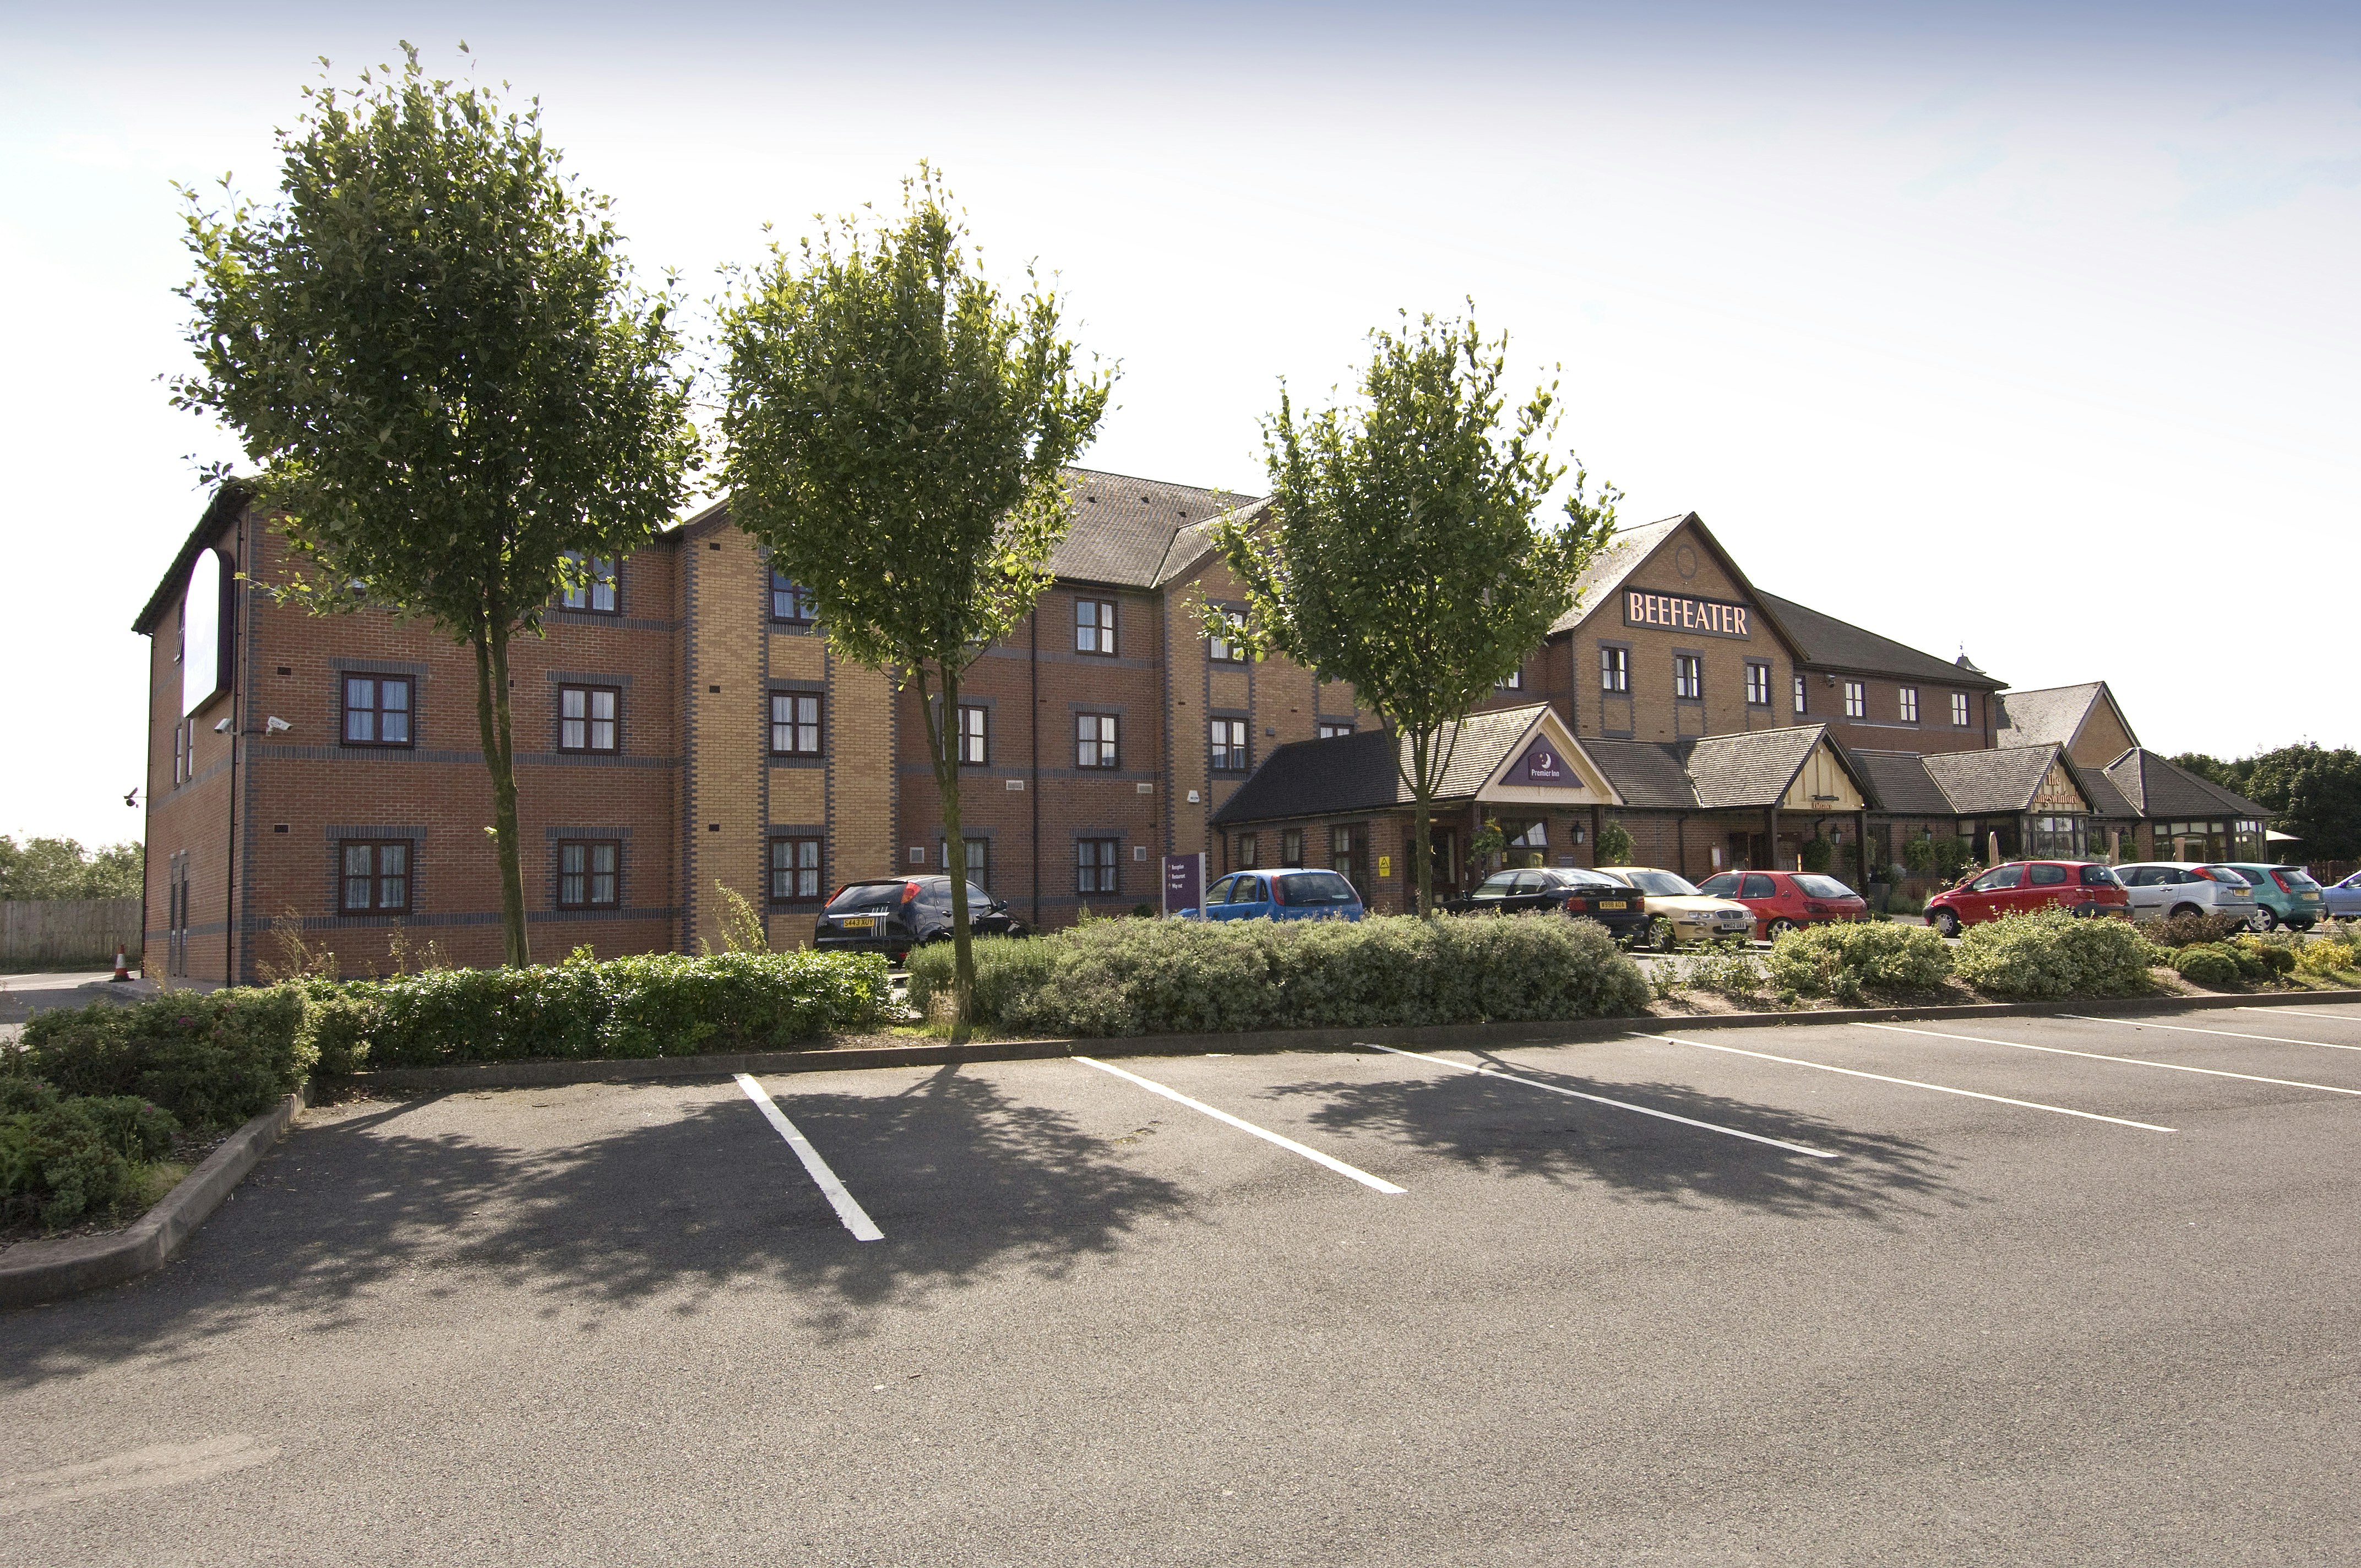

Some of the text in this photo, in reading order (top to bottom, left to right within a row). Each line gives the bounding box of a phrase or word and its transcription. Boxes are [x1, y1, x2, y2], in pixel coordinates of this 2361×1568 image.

[1629, 592, 1748, 635] BEEFEATER
[1531, 769, 1551, 777] Premier
[2046, 772, 2060, 786] The
